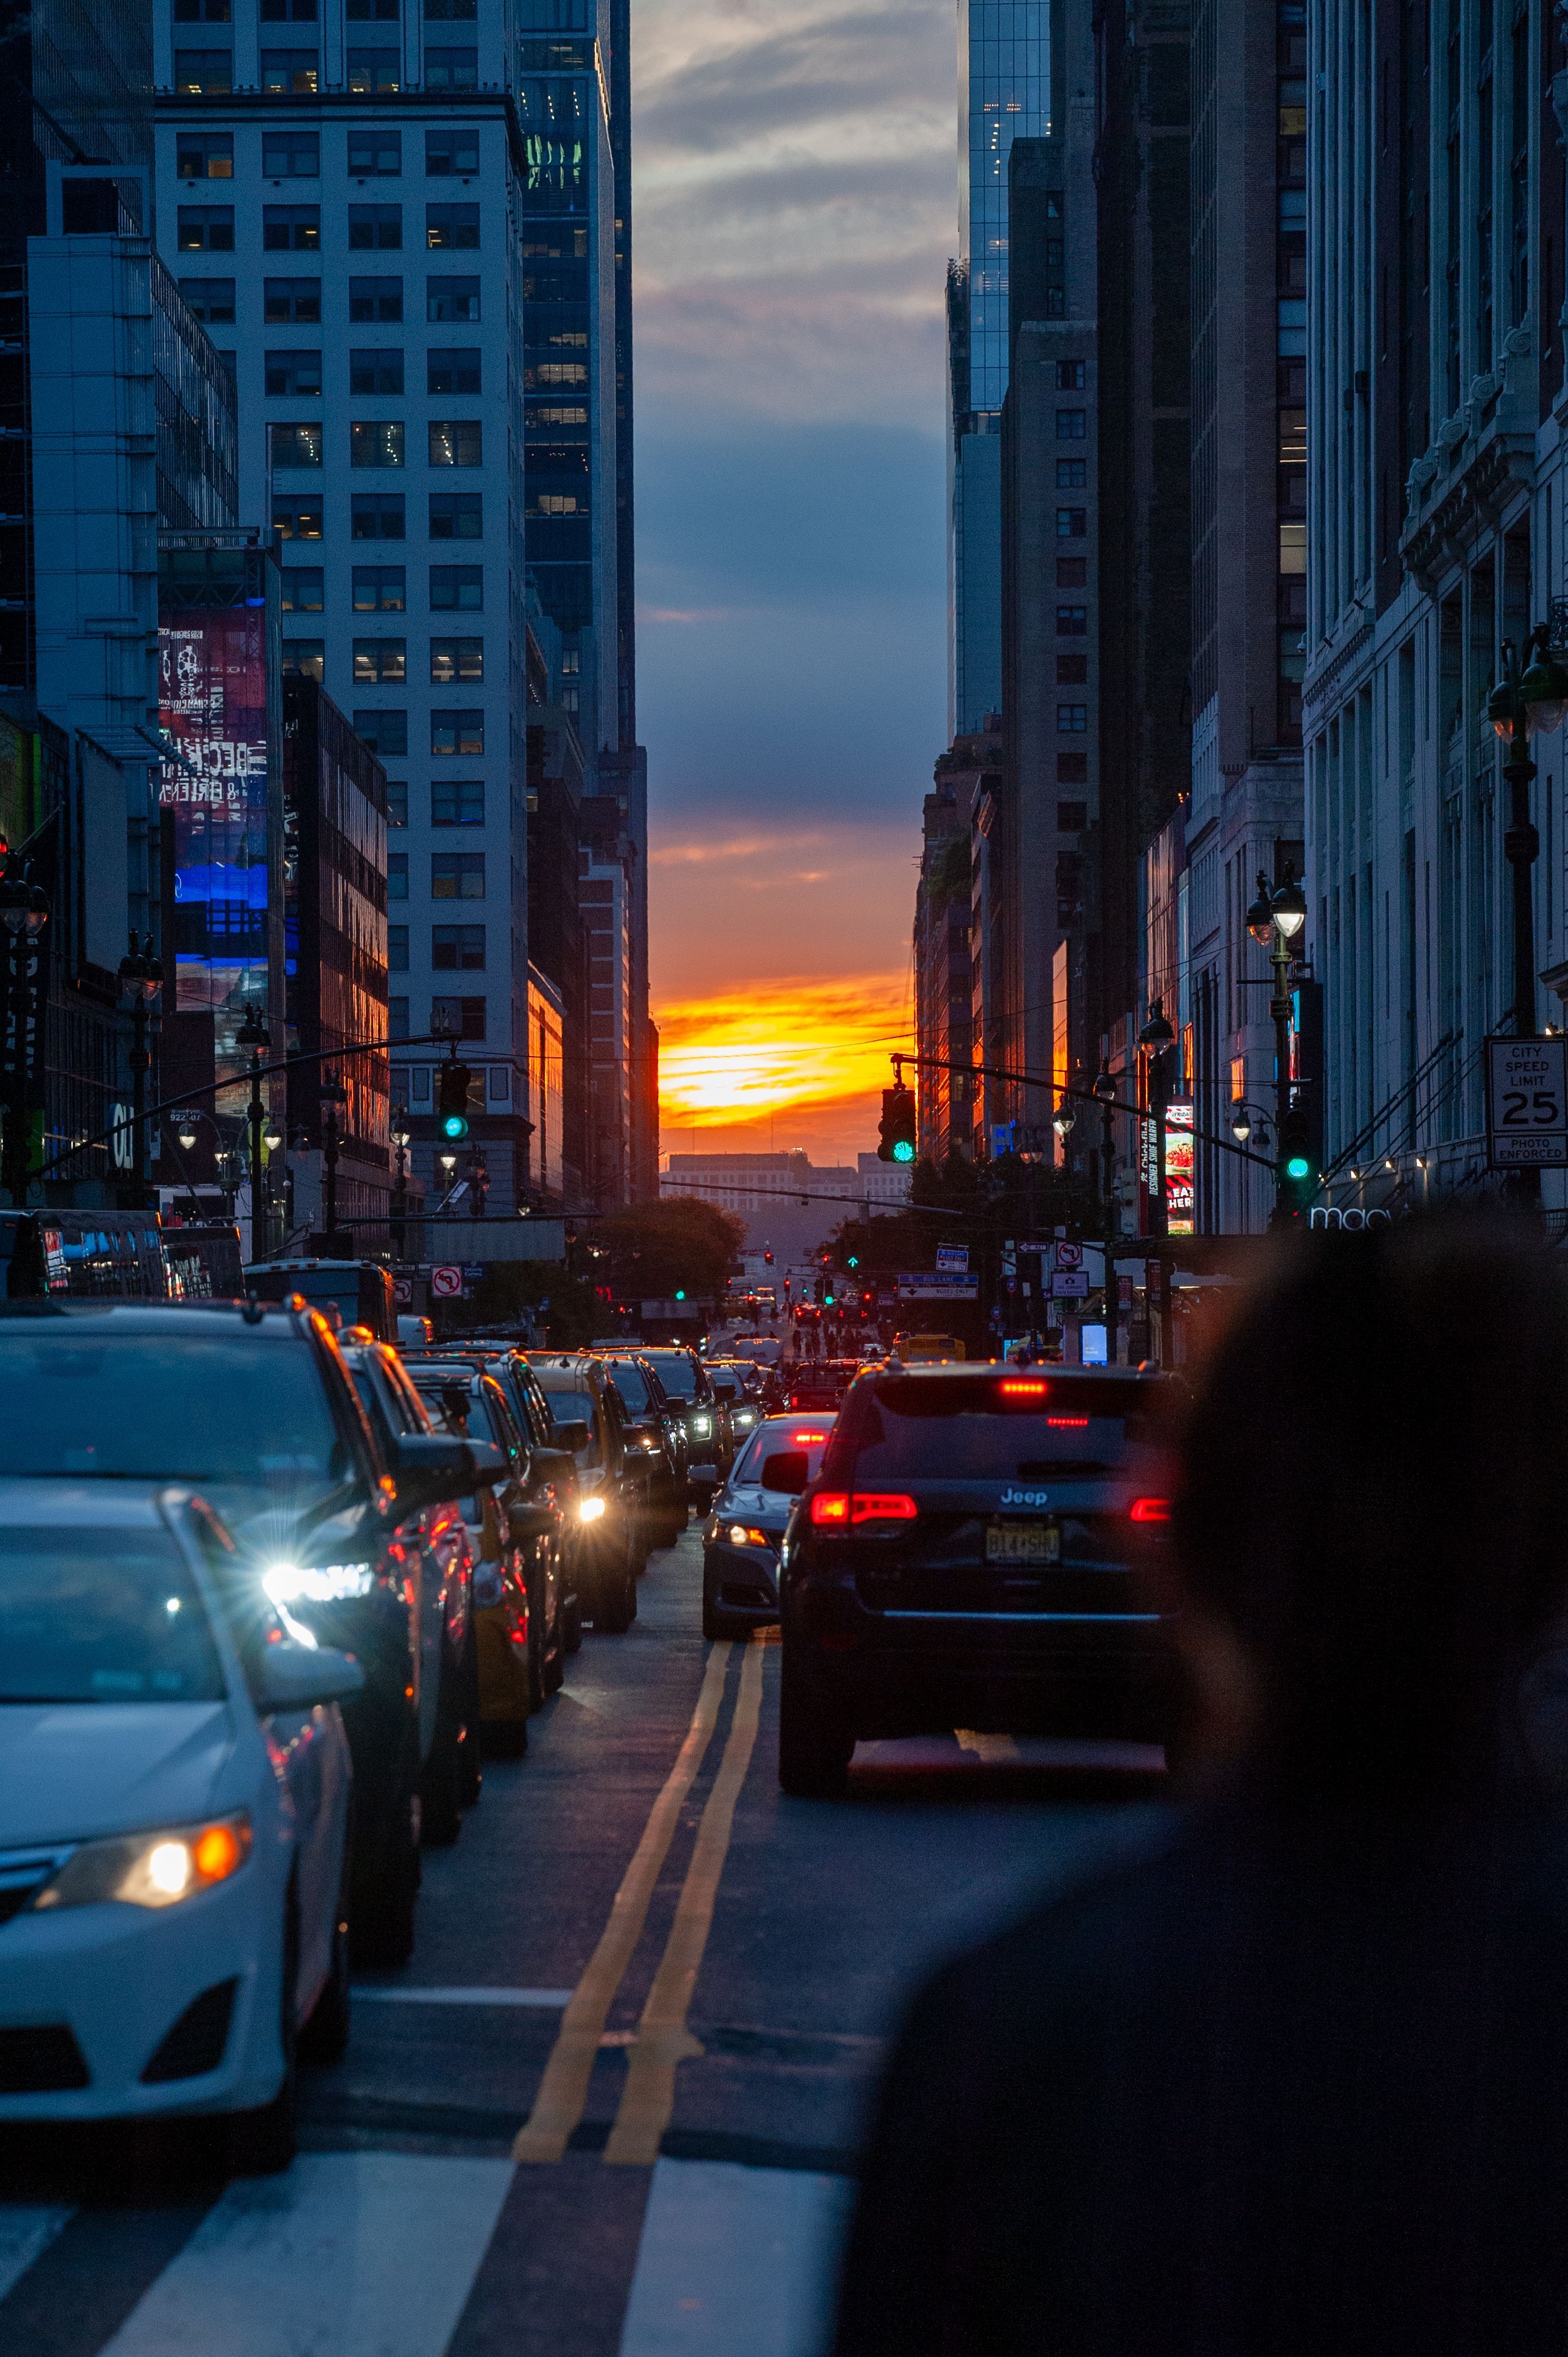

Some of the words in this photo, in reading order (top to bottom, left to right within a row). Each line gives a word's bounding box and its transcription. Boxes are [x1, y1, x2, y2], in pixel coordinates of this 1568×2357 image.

[1512, 1047, 1542, 1058] CITY
[1505, 1061, 1549, 1072] SPEED
[1511, 1075, 1545, 1087] LIMIT
[1502, 1092, 1559, 1125] 25
[1511, 1139, 1550, 1149] PHOTO
[1148, 1144, 1158, 1163] SHOE
[1500, 1149, 1562, 1159] ENFORCED
[1148, 1163, 1158, 1196] DESIGNER
[1168, 1197, 1194, 1209] HER
[1001, 1487, 1048, 1507] Jeep
